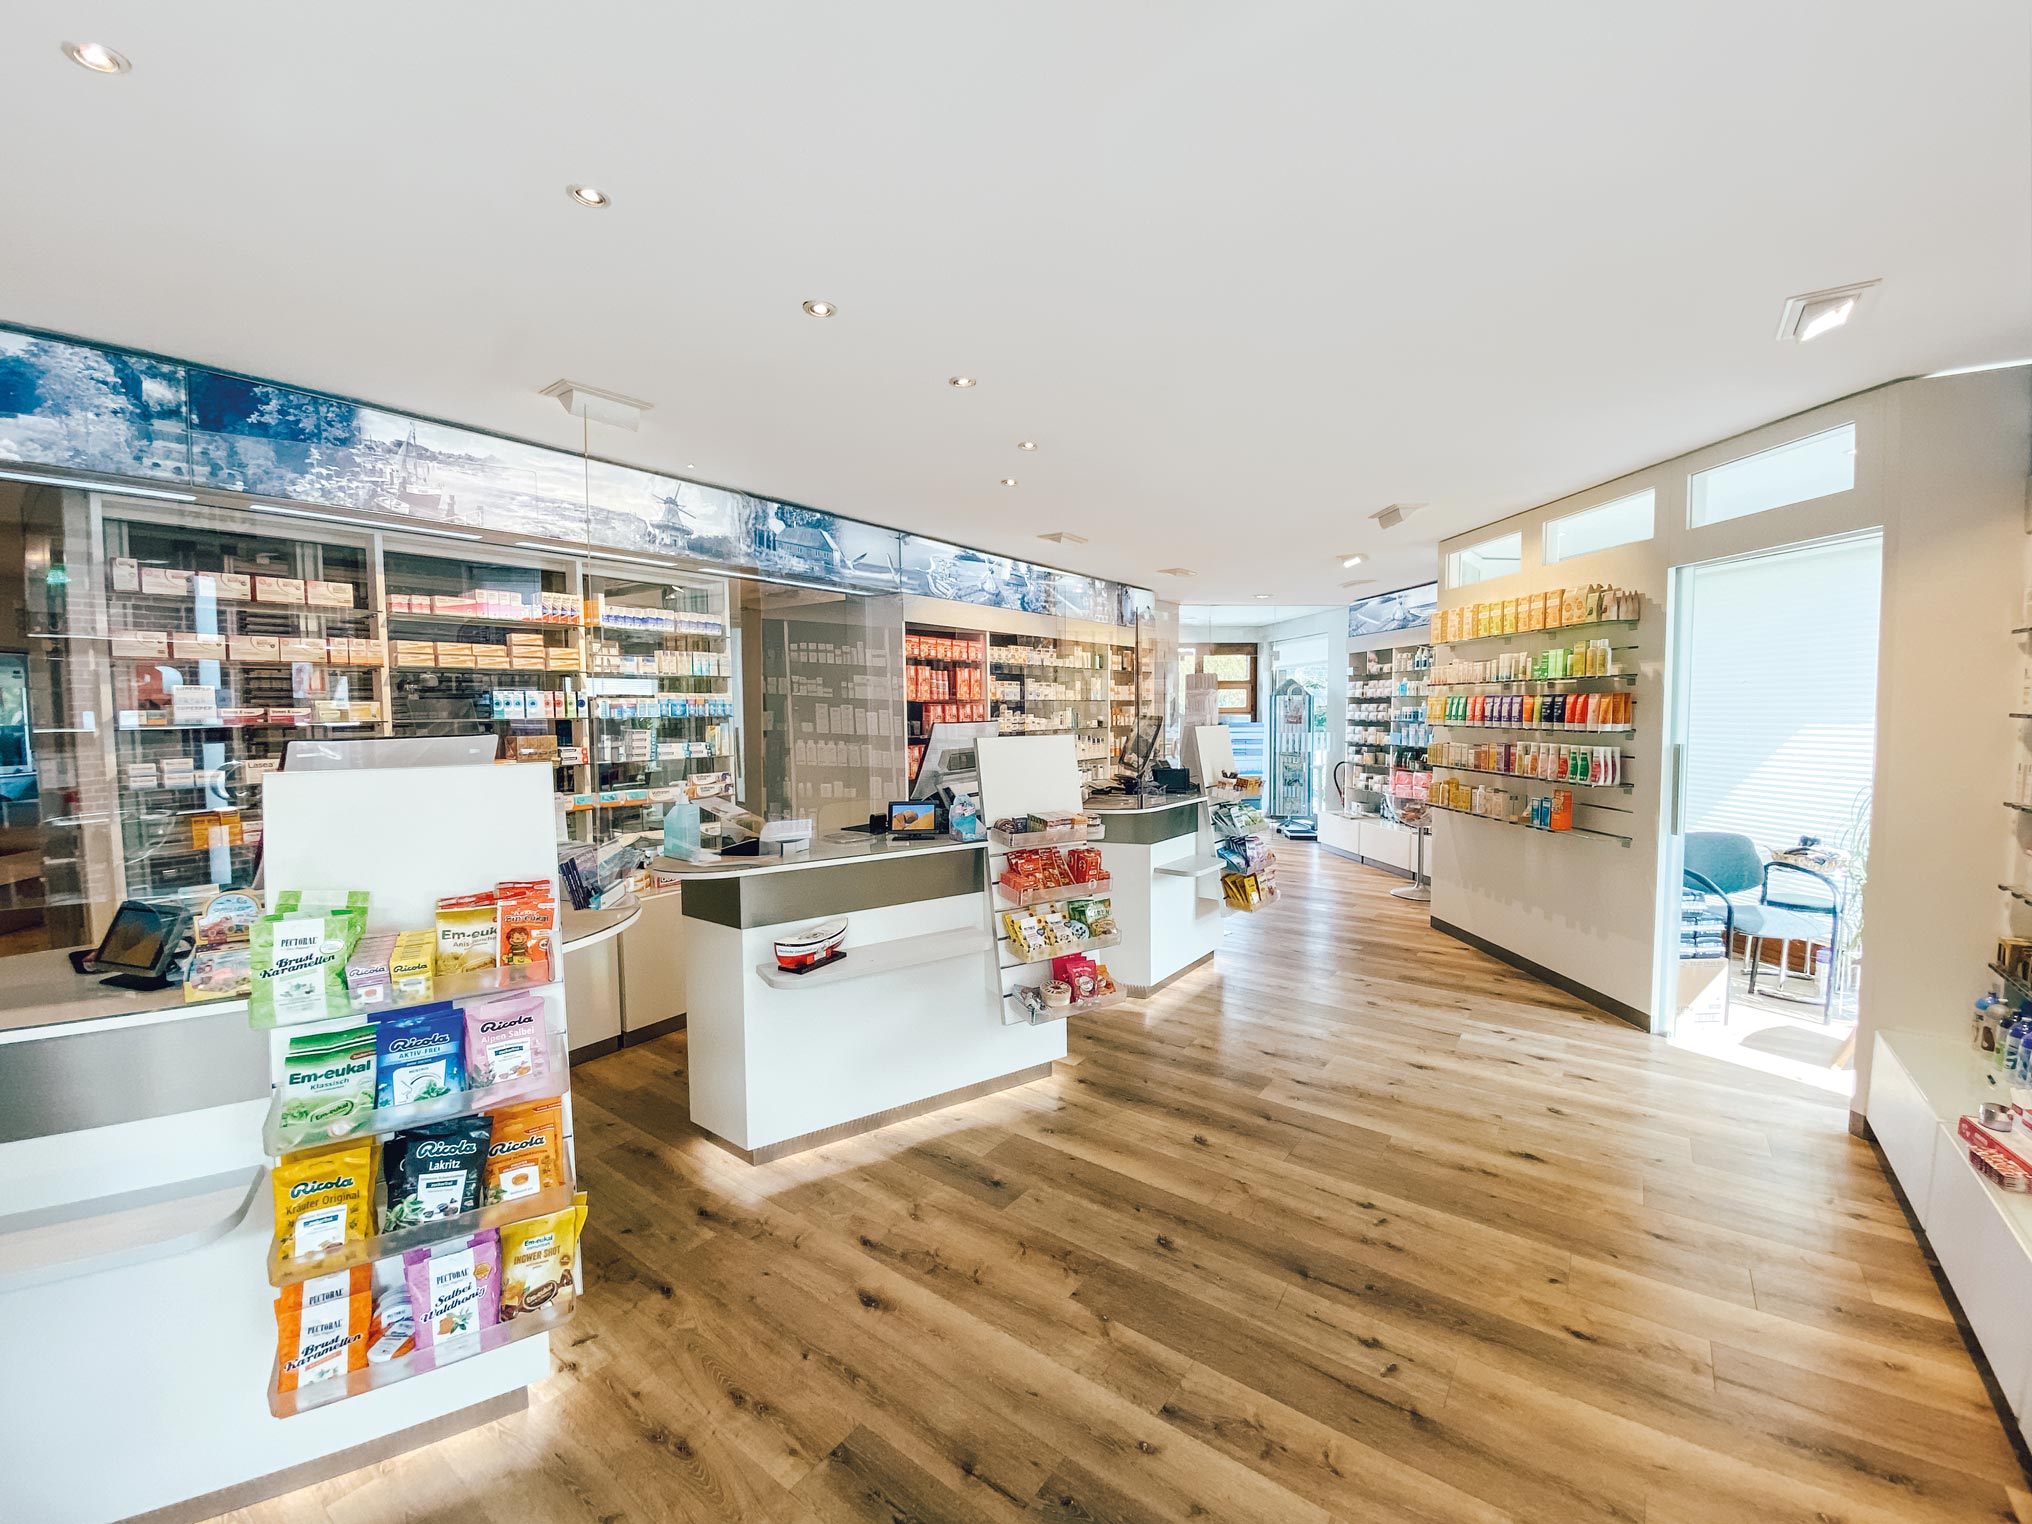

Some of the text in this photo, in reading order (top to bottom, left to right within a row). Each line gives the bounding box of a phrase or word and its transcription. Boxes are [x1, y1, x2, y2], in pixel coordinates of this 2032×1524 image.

[281, 936, 318, 948] PECTORAL
[442, 926, 497, 940] Em-euk
[260, 954, 336, 979] Karamellen
[276, 953, 314, 969] Brust
[394, 963, 428, 973] Ricola
[349, 966, 386, 977] Ricola
[480, 1015, 534, 1034] Ricola
[389, 1033, 450, 1053] Ricola
[481, 1026, 535, 1044] Alpen Salbei
[288, 1060, 372, 1086] Em-eukal
[310, 1078, 350, 1091] Klassisch
[416, 1140, 477, 1159] Ricola
[488, 1134, 546, 1158] Ricola
[429, 1160, 461, 1171] Lakritz
[290, 1176, 354, 1199] Ricola
[322, 1189, 360, 1205] Original
[524, 1235, 553, 1247] Em-eukal
[514, 1250, 542, 1266] INGWER
[543, 1245, 561, 1258] SHOT
[436, 1268, 469, 1285] PECTORAL
[309, 1288, 343, 1305] PECTORAL
[435, 1282, 472, 1307] Salbei
[421, 1287, 487, 1323] Waldhonig
[307, 1319, 342, 1336] PECTORAL
[284, 1334, 363, 1372] Karamellen
[301, 1335, 341, 1357] Brust
